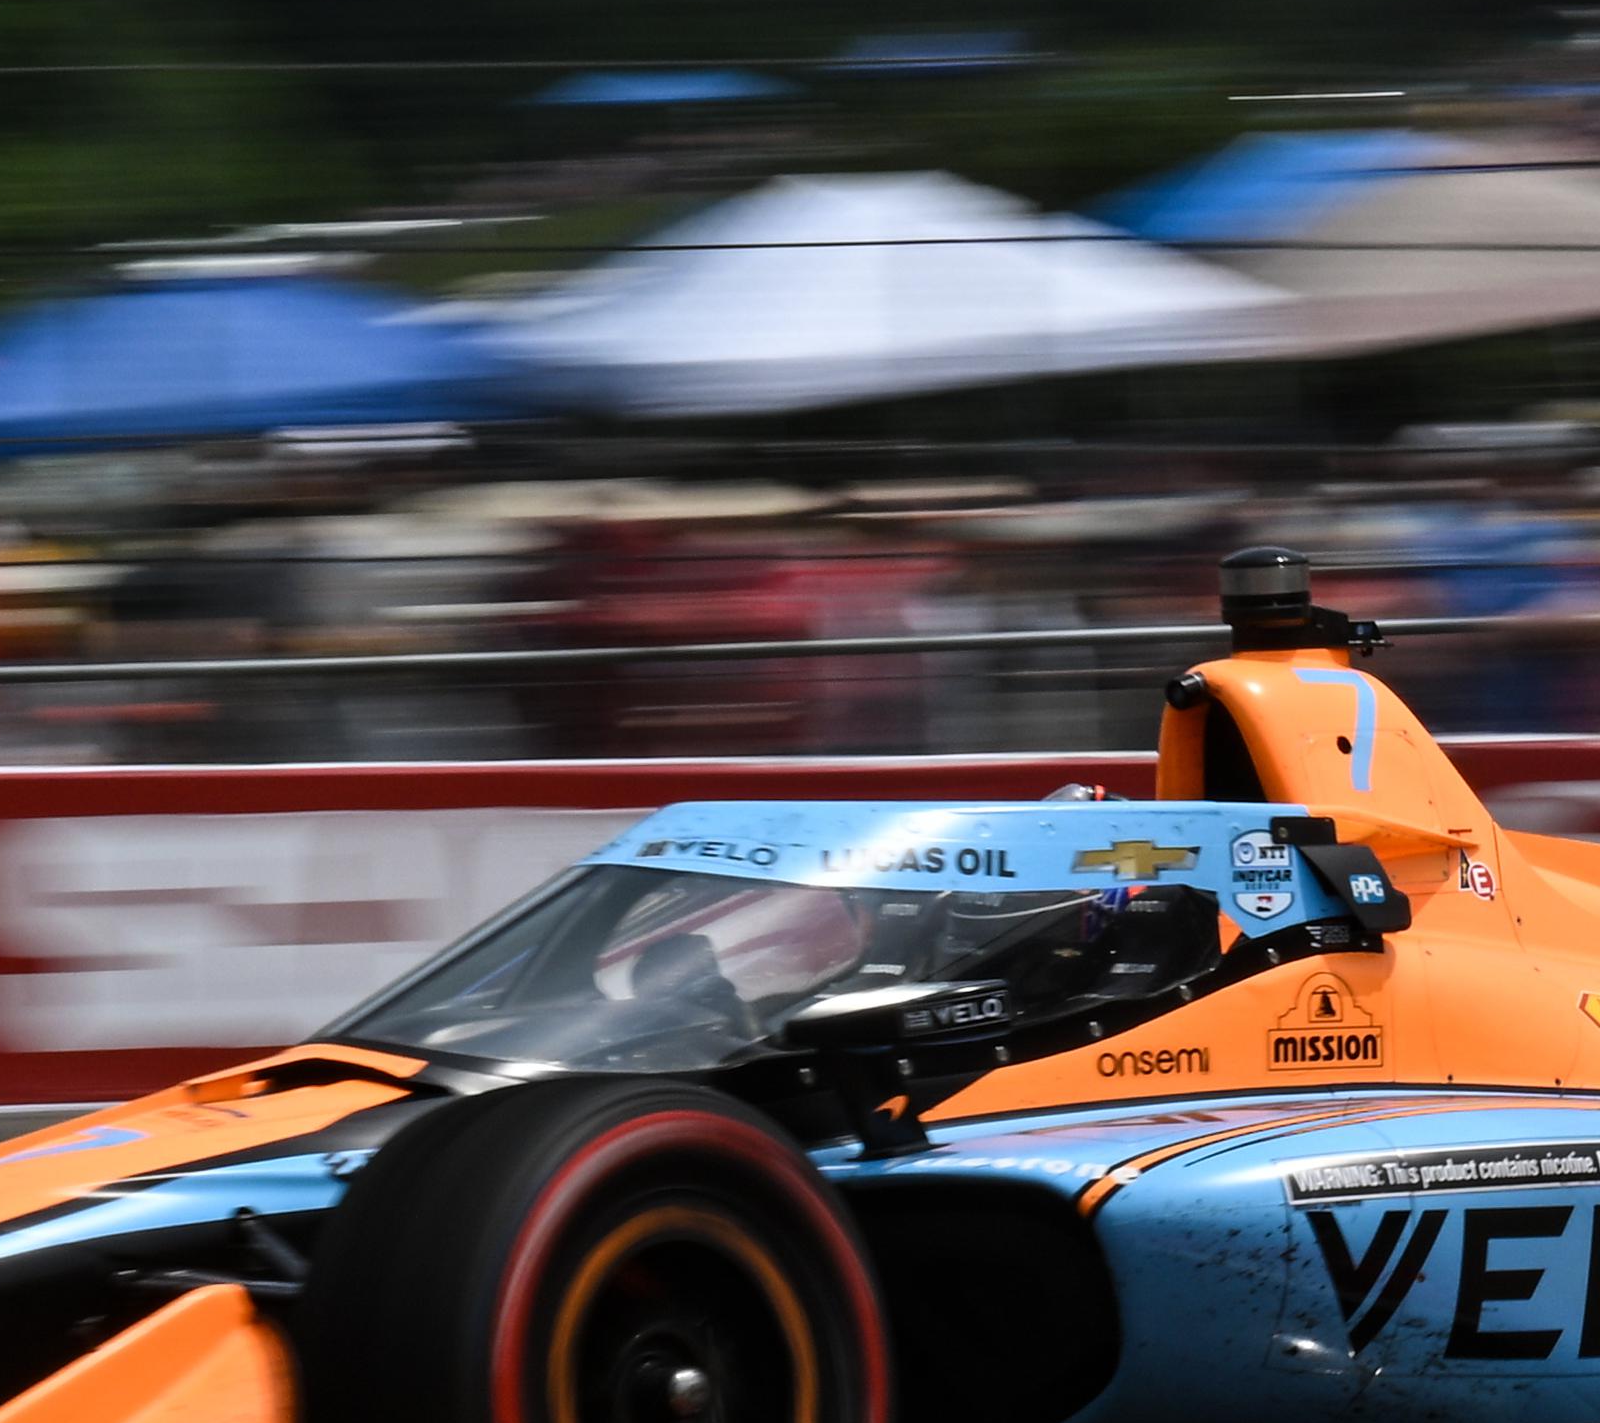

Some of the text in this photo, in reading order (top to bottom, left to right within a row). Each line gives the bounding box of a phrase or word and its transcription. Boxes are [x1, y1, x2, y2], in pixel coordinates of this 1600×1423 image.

[1291, 668, 1376, 792] 7
[672, 841, 778, 866] VELO
[821, 847, 1017, 877] LUCAS OIL
[1258, 846, 1285, 859] NTT
[1232, 869, 1292, 882] INDYCAR
[1351, 875, 1384, 901] PPG
[938, 998, 1003, 1025] VELO
[1097, 1047, 1209, 1077] onsemi
[1273, 1035, 1378, 1063] MISSION
[1293, 1164, 1384, 1192] WARNING:
[1385, 1162, 1419, 1185] This
[1420, 1159, 1477, 1188] product
[1479, 1154, 1539, 1178] contains
[1541, 1152, 1597, 1175] nicotine.
